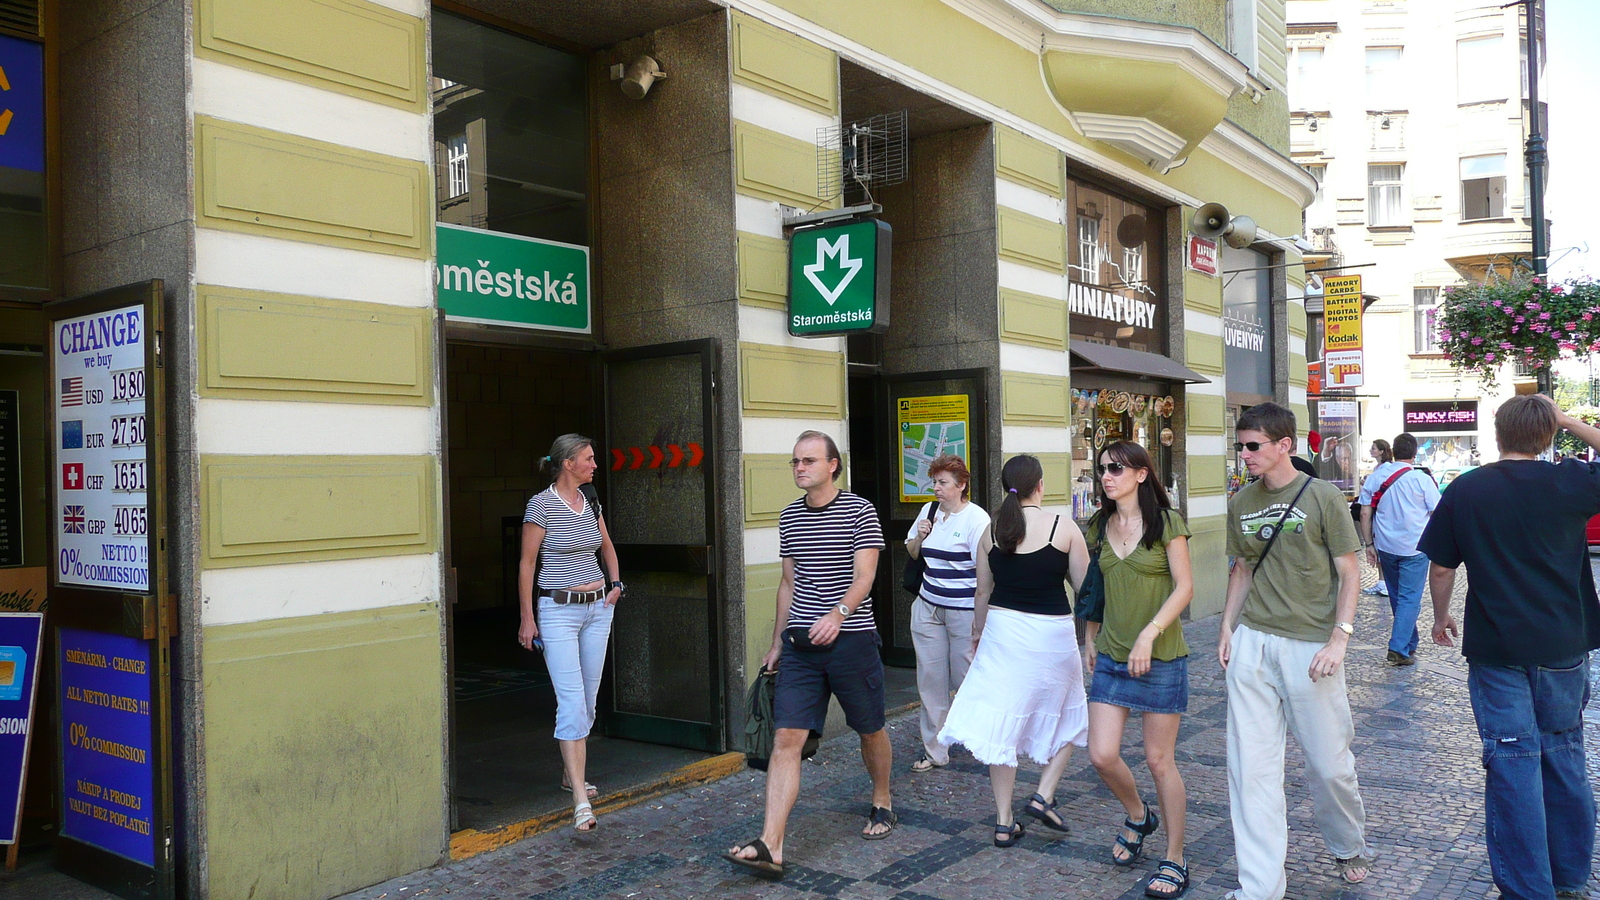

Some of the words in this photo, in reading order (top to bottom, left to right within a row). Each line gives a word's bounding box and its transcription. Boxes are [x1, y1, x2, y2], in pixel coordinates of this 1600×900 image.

[1069, 283, 1156, 330] MINIATURY
[793, 307, 872, 327] Staroměstská
[60, 311, 140, 355] CHANGE
[1328, 334, 1358, 343] Kodak
[84, 356, 95, 368] we
[97, 352, 112, 369] buy
[86, 389, 103, 404] USD
[1407, 411, 1446, 420] FUNKY
[1448, 411, 1475, 419] FISH
[86, 433, 104, 448] EUR
[86, 475, 104, 489] CHF
[88, 519, 106, 534] GBP
[102, 544, 137, 562] NETTO
[60, 548, 82, 576] 0%
[84, 564, 148, 585] COMMISSION
[66, 647, 107, 668] SMĚNÁRNA
[112, 656, 146, 675] CHANGE
[67, 686, 81, 701] ALL
[83, 689, 110, 707] NETTO
[111, 694, 138, 713] RATES
[70, 722, 90, 750] 0%
[91, 737, 146, 764] COMMISSION
[77, 778, 101, 798] NÁKUP
[103, 787, 109, 800] A
[110, 789, 141, 810] PRODEJ
[69, 797, 92, 816] VALUT
[93, 806, 108, 821] BEZ
[109, 810, 150, 836] POPLATKŮ
